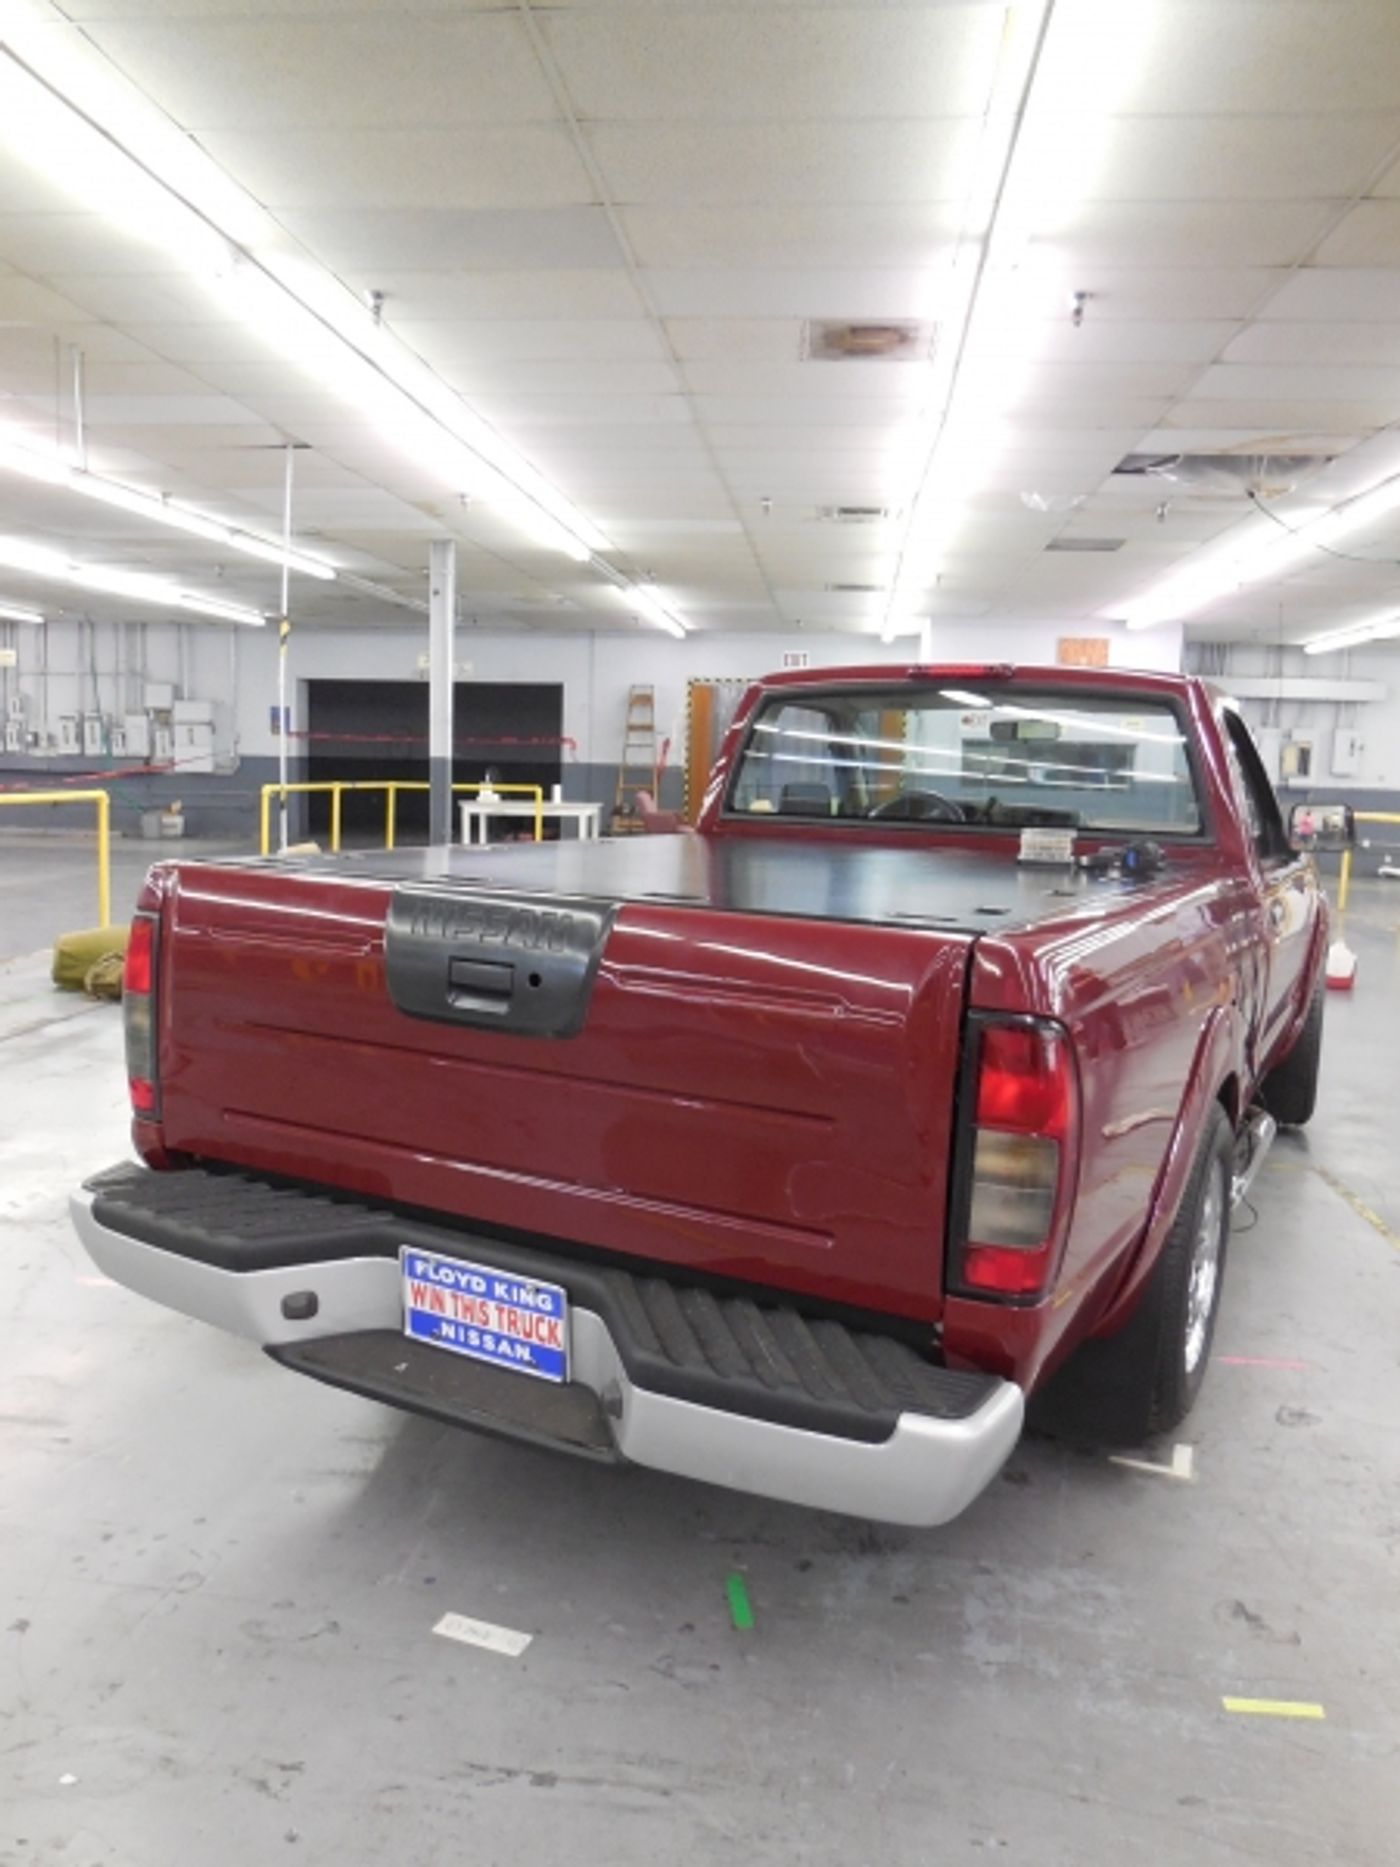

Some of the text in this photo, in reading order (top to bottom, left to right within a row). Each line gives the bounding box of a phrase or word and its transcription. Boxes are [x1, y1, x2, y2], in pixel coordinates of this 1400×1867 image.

[414, 1260, 553, 1311] FLOYD KING
[411, 1282, 562, 1348] WIN THIS TRUCK
[440, 1322, 533, 1362] NISSAN
